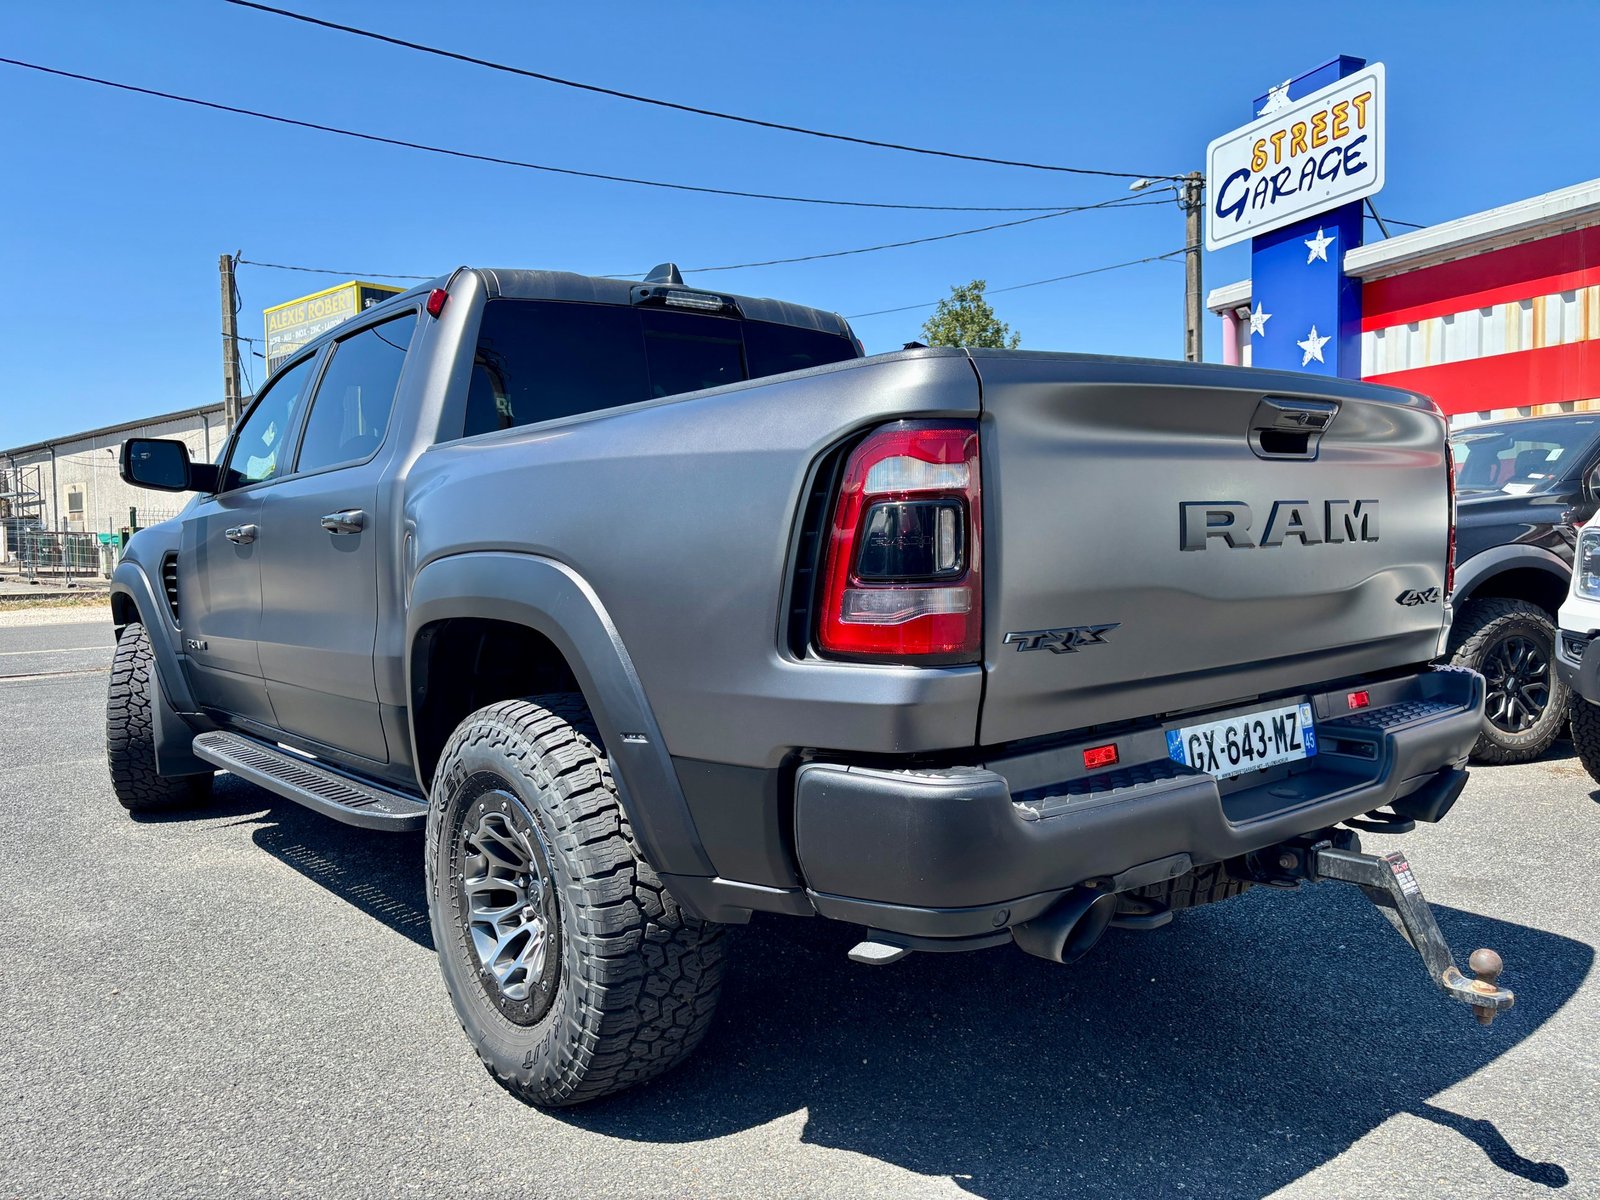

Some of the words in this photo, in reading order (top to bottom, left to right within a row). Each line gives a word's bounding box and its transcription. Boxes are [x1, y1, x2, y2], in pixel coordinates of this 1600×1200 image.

[1251, 91, 1372, 173] STREET
[1215, 134, 1368, 222] GARAGE
[269, 304, 305, 331] ALEXIS
[307, 290, 353, 320] ROBERT
[1179, 500, 1379, 551] RAM
[1002, 622, 1122, 654] TRX
[1188, 712, 1302, 773] GX-643-MZ
[1305, 732, 1315, 749] 45
